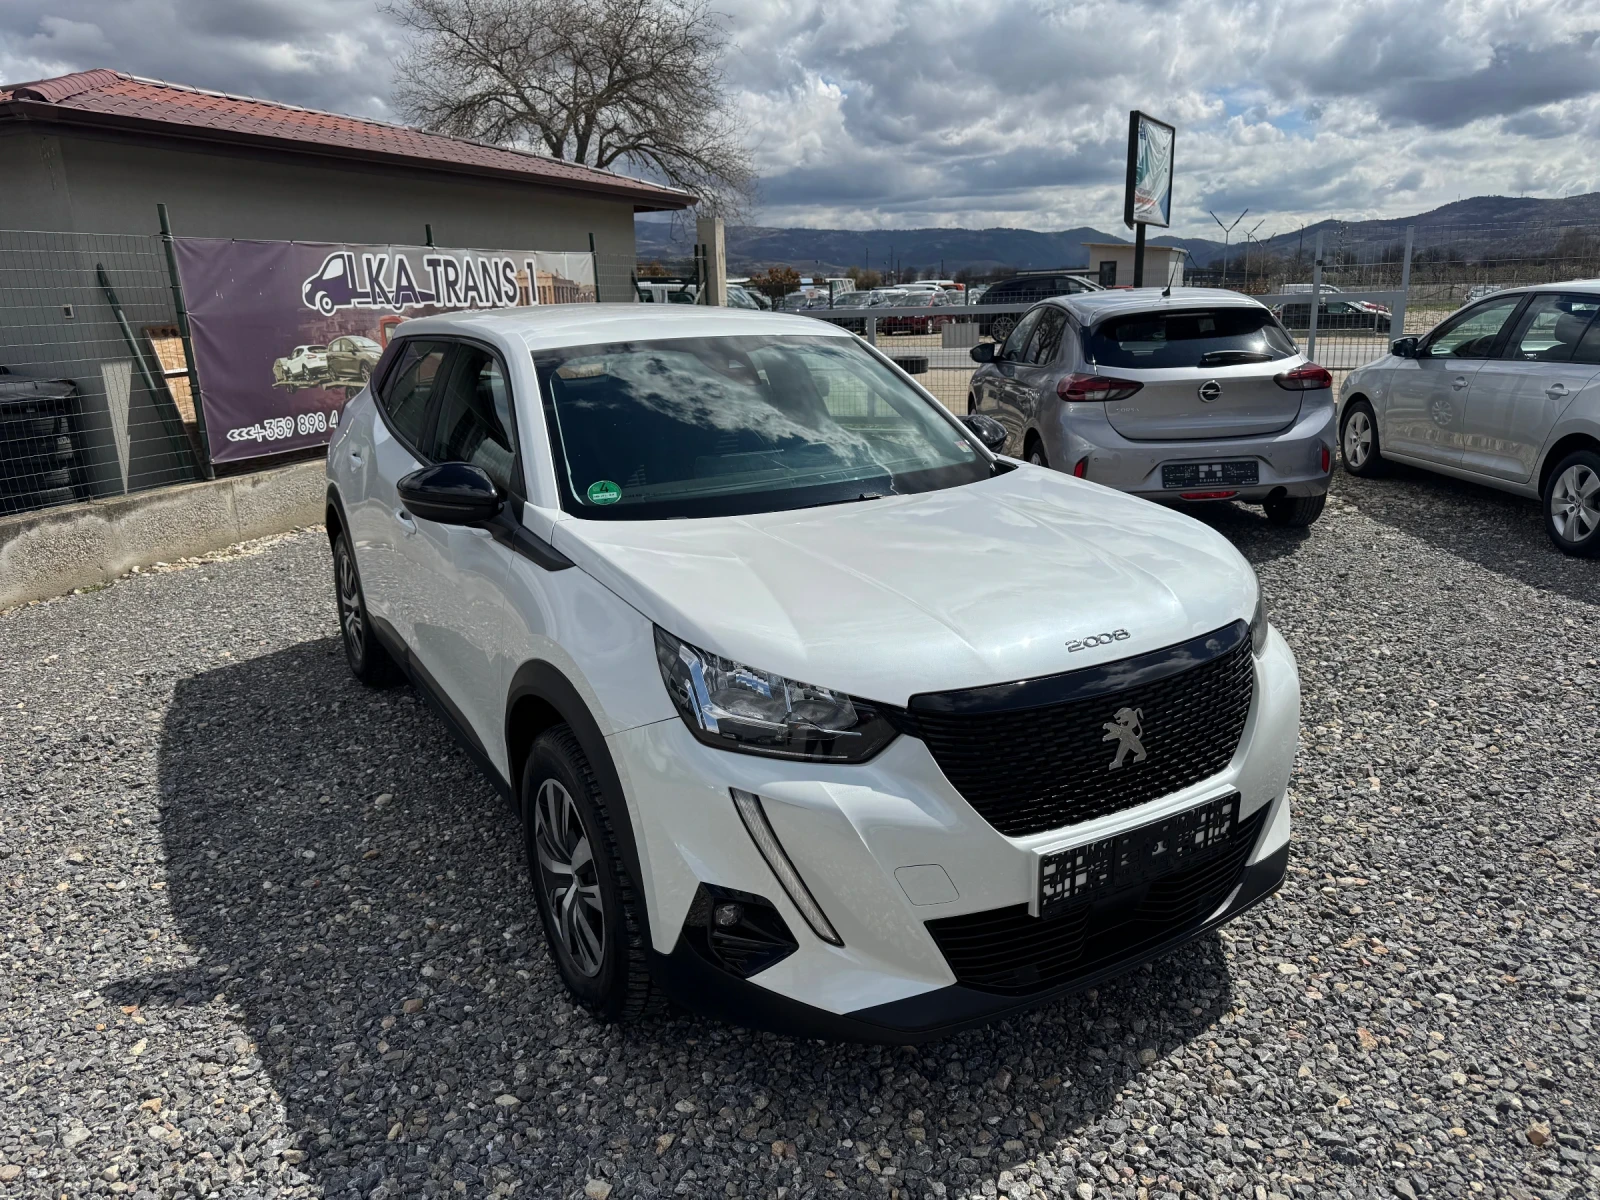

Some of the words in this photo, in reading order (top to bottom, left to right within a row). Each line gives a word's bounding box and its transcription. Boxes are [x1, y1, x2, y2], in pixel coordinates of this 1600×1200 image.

[425, 255, 519, 306] TRANS
[525, 258, 538, 305] 1
[254, 417, 294, 441] +359
[298, 412, 326, 435] 898
[600, 482, 609, 493] 4
[1065, 629, 1131, 653] 2008
